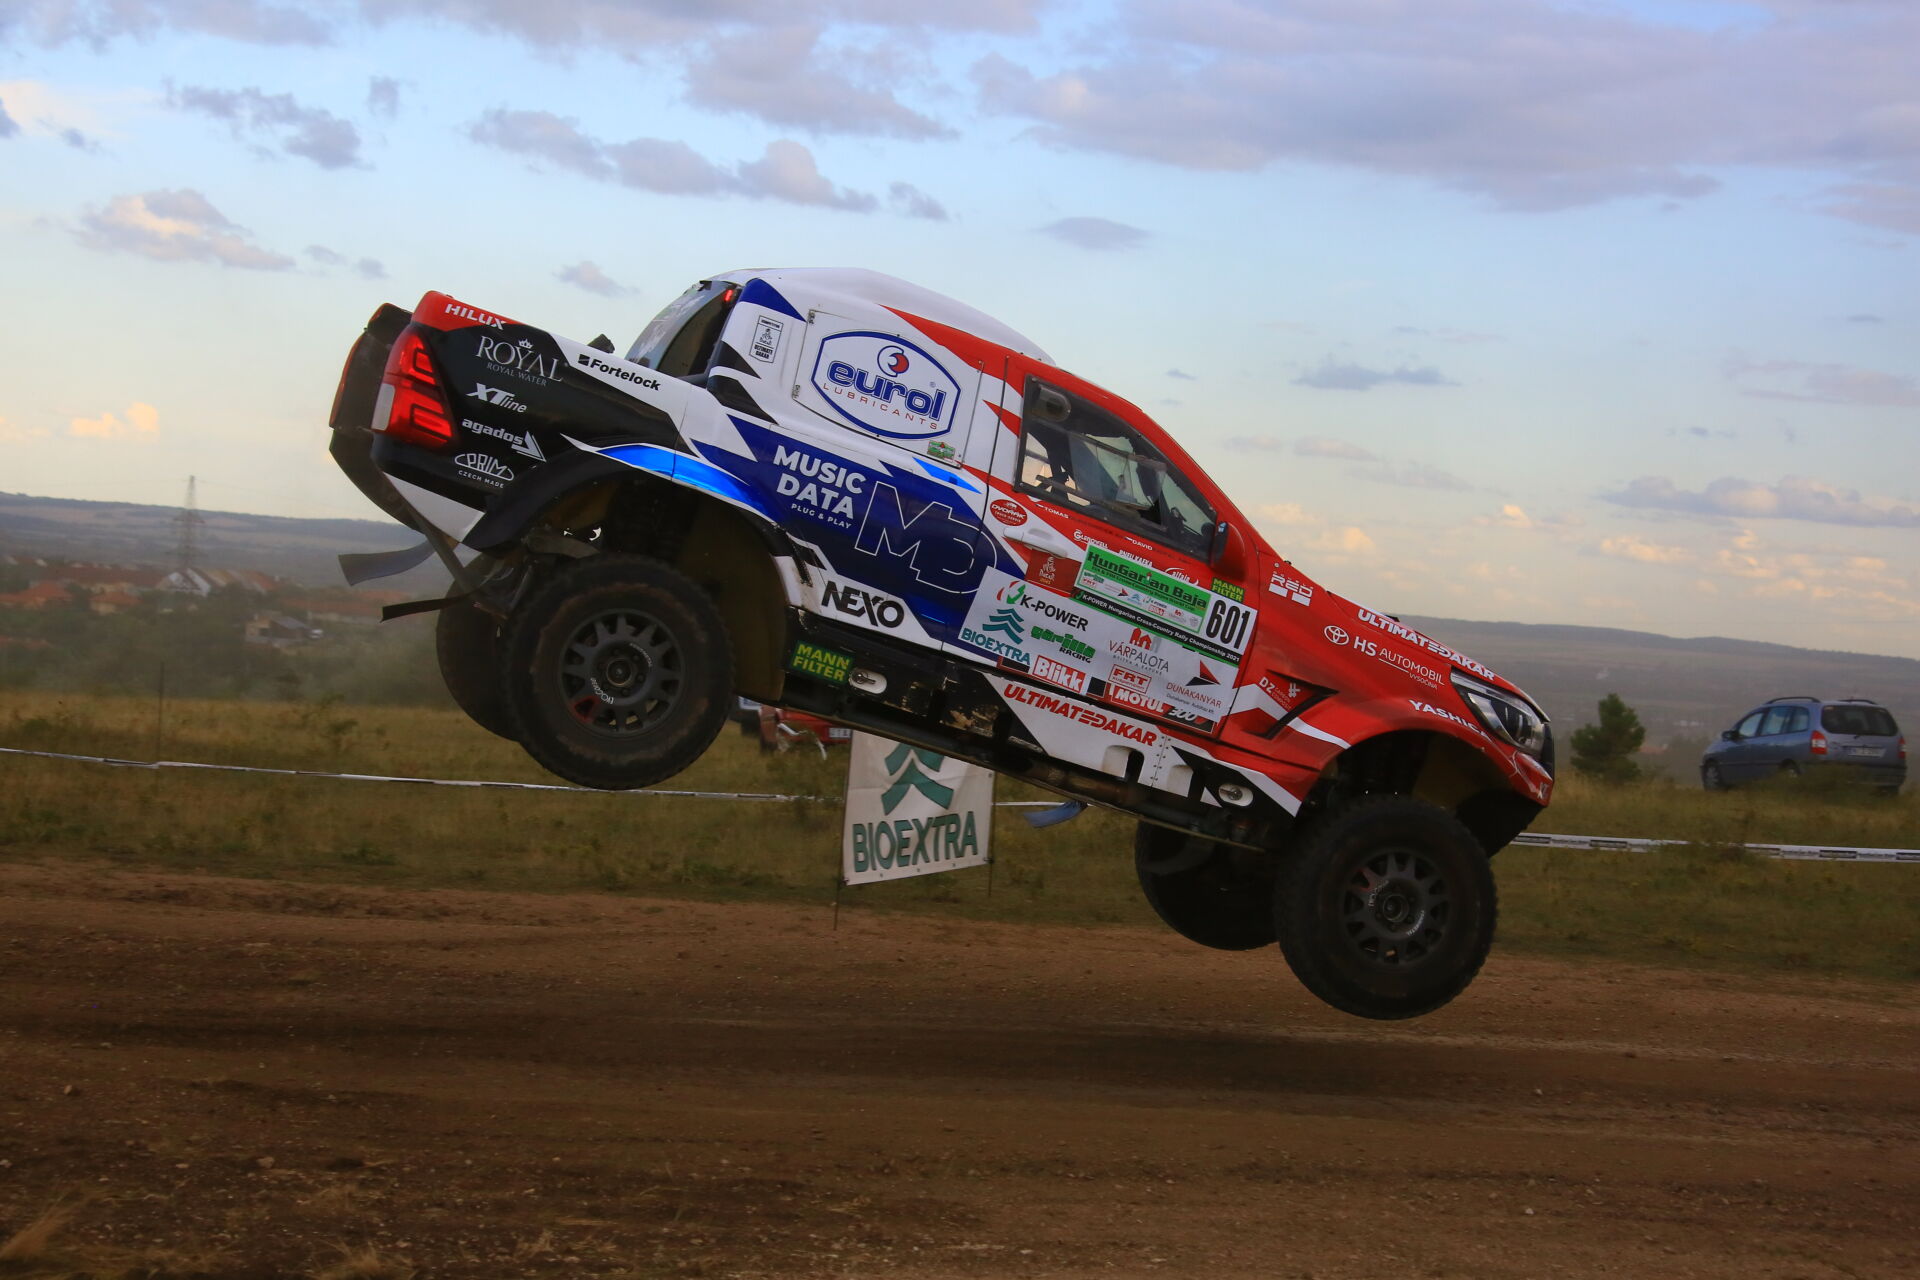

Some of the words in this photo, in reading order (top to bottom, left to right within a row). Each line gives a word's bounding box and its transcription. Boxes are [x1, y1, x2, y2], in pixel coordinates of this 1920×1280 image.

[445, 303, 504, 330] HILUX
[476, 335, 563, 382] ROYAL
[486, 362, 515, 377] ROYAL
[518, 371, 548, 386] WATER
[590, 358, 662, 391] Fortelock
[827, 360, 949, 422] eurol
[823, 382, 939, 430] LUBRICANTS
[462, 418, 524, 446] agados
[465, 453, 509, 477] PRIM
[773, 446, 867, 494] MUSIC
[458, 470, 482, 481] CZECH
[484, 479, 504, 488] MADE
[776, 475, 855, 519] DATA
[791, 503, 815, 517] PLUG
[818, 513, 825, 521] &
[827, 516, 853, 530] PLAY
[1132, 538, 1153, 551] DAVID
[1172, 585, 1207, 607] Baja
[1212, 585, 1243, 602] FILTER
[1213, 579, 1244, 594] MANN
[821, 580, 905, 628] NEXO
[1020, 595, 1088, 631] K-POWER
[1082, 594, 1109, 608] K-POWER
[1108, 604, 1136, 620] Hungarian
[1136, 615, 1175, 636] Cross-Country
[1174, 630, 1189, 643] Rally
[1189, 637, 1226, 657] Championship
[1226, 652, 1240, 663] 2021
[1205, 599, 1250, 649] 601
[796, 644, 850, 671] MANN
[961, 628, 1031, 665] BIOEXTRA
[1059, 647, 1091, 663] RACING
[1109, 639, 1169, 672] VÁRPALOTA
[792, 655, 847, 682] FILTER
[1035, 656, 1083, 690] Blikk
[1353, 636, 1377, 657] HS
[1378, 647, 1446, 686] AUTOMOBIL
[1113, 668, 1149, 685] FRT
[1259, 676, 1276, 693] DZ
[1115, 687, 1165, 713] MOTUL
[1166, 682, 1222, 708] DUNAKANYAR
[852, 811, 978, 873] BIOEXTRA
